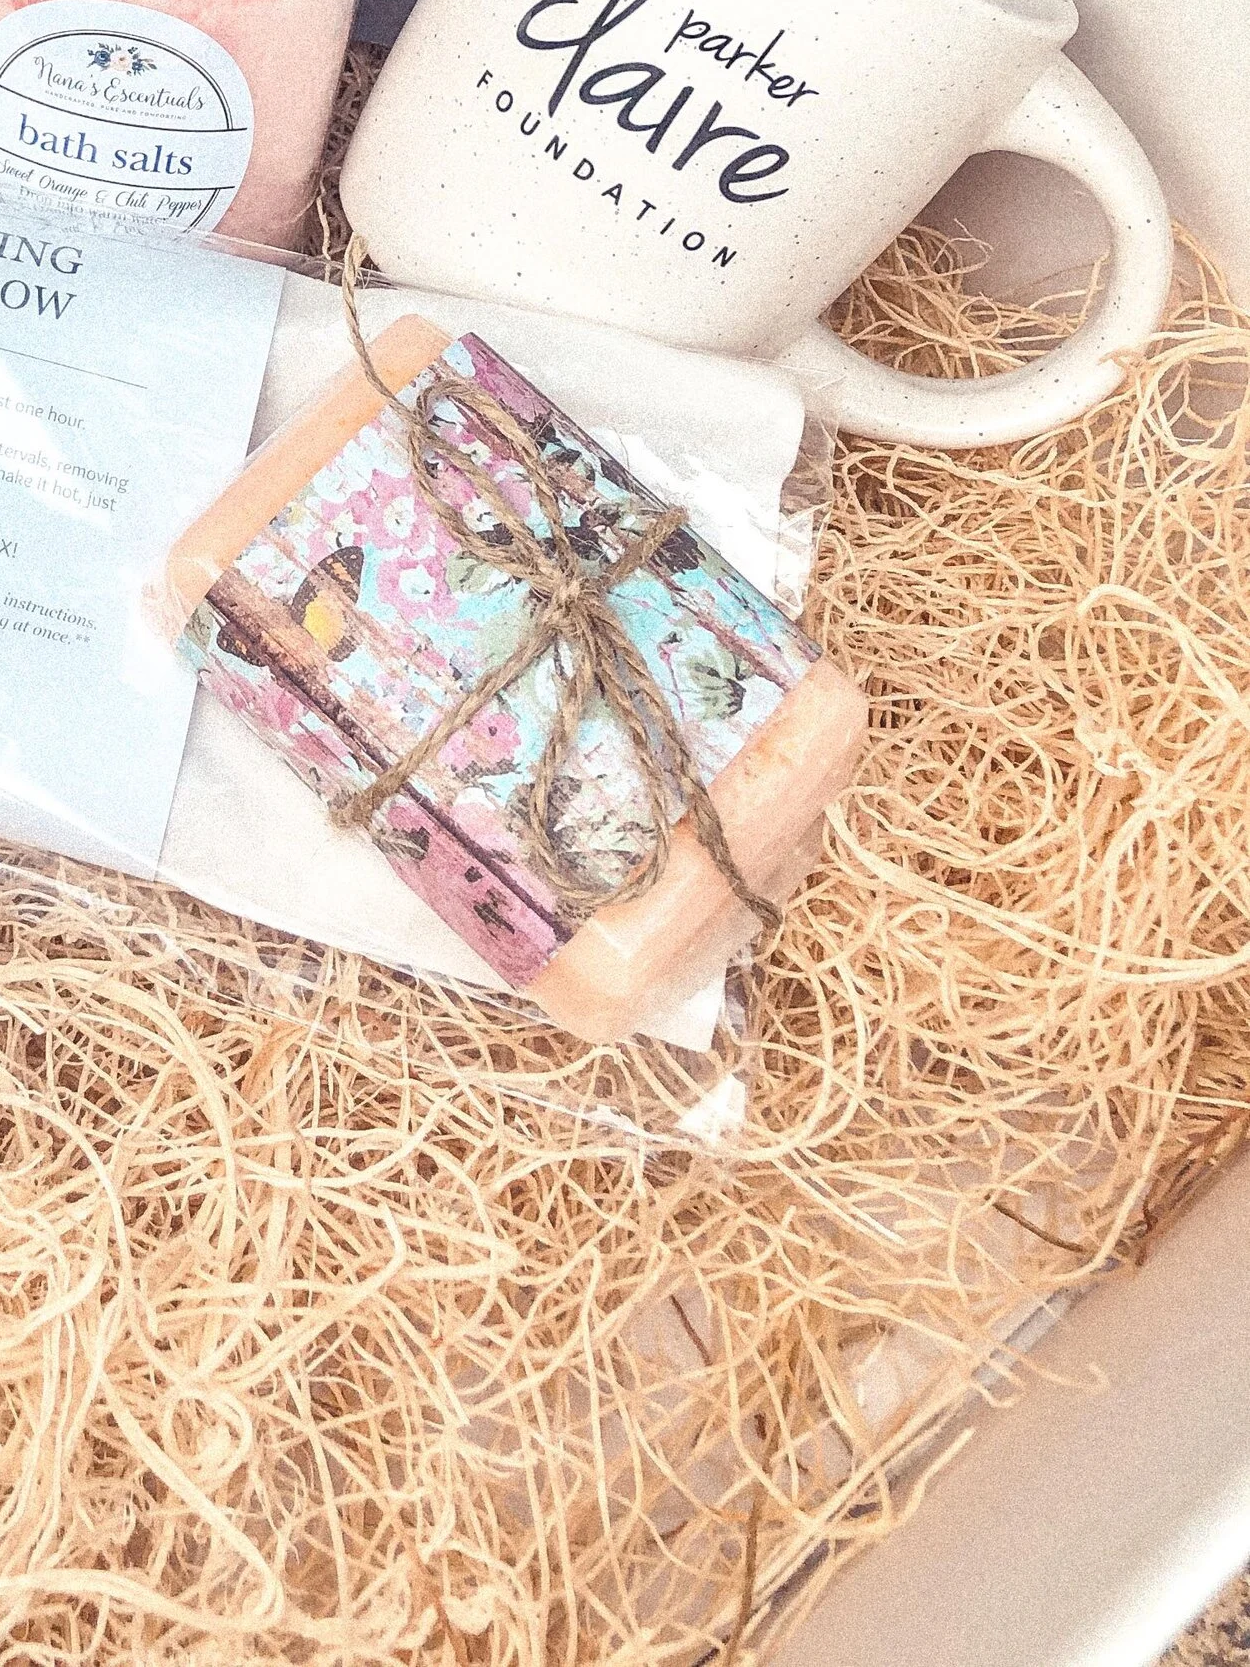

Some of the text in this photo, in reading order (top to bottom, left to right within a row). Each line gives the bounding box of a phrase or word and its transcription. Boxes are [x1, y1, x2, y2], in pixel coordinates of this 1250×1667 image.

[664, 9, 820, 107] parker
[34, 56, 207, 111] Nana's Escentuals
[19, 114, 193, 175] bath salts
[476, 70, 737, 267] FOUNDATION
[39, 175, 88, 205] Orange
[95, 190, 108, 204] &
[156, 194, 203, 218] Pepper
[15, 401, 44, 418] one
[47, 405, 86, 431] hour.
[52, 479, 82, 504] hot,
[86, 491, 117, 512] just
[56, 460, 130, 494] removing
[3, 592, 97, 631] instructions.
[13, 618, 30, 633] at
[32, 627, 72, 645] once.
